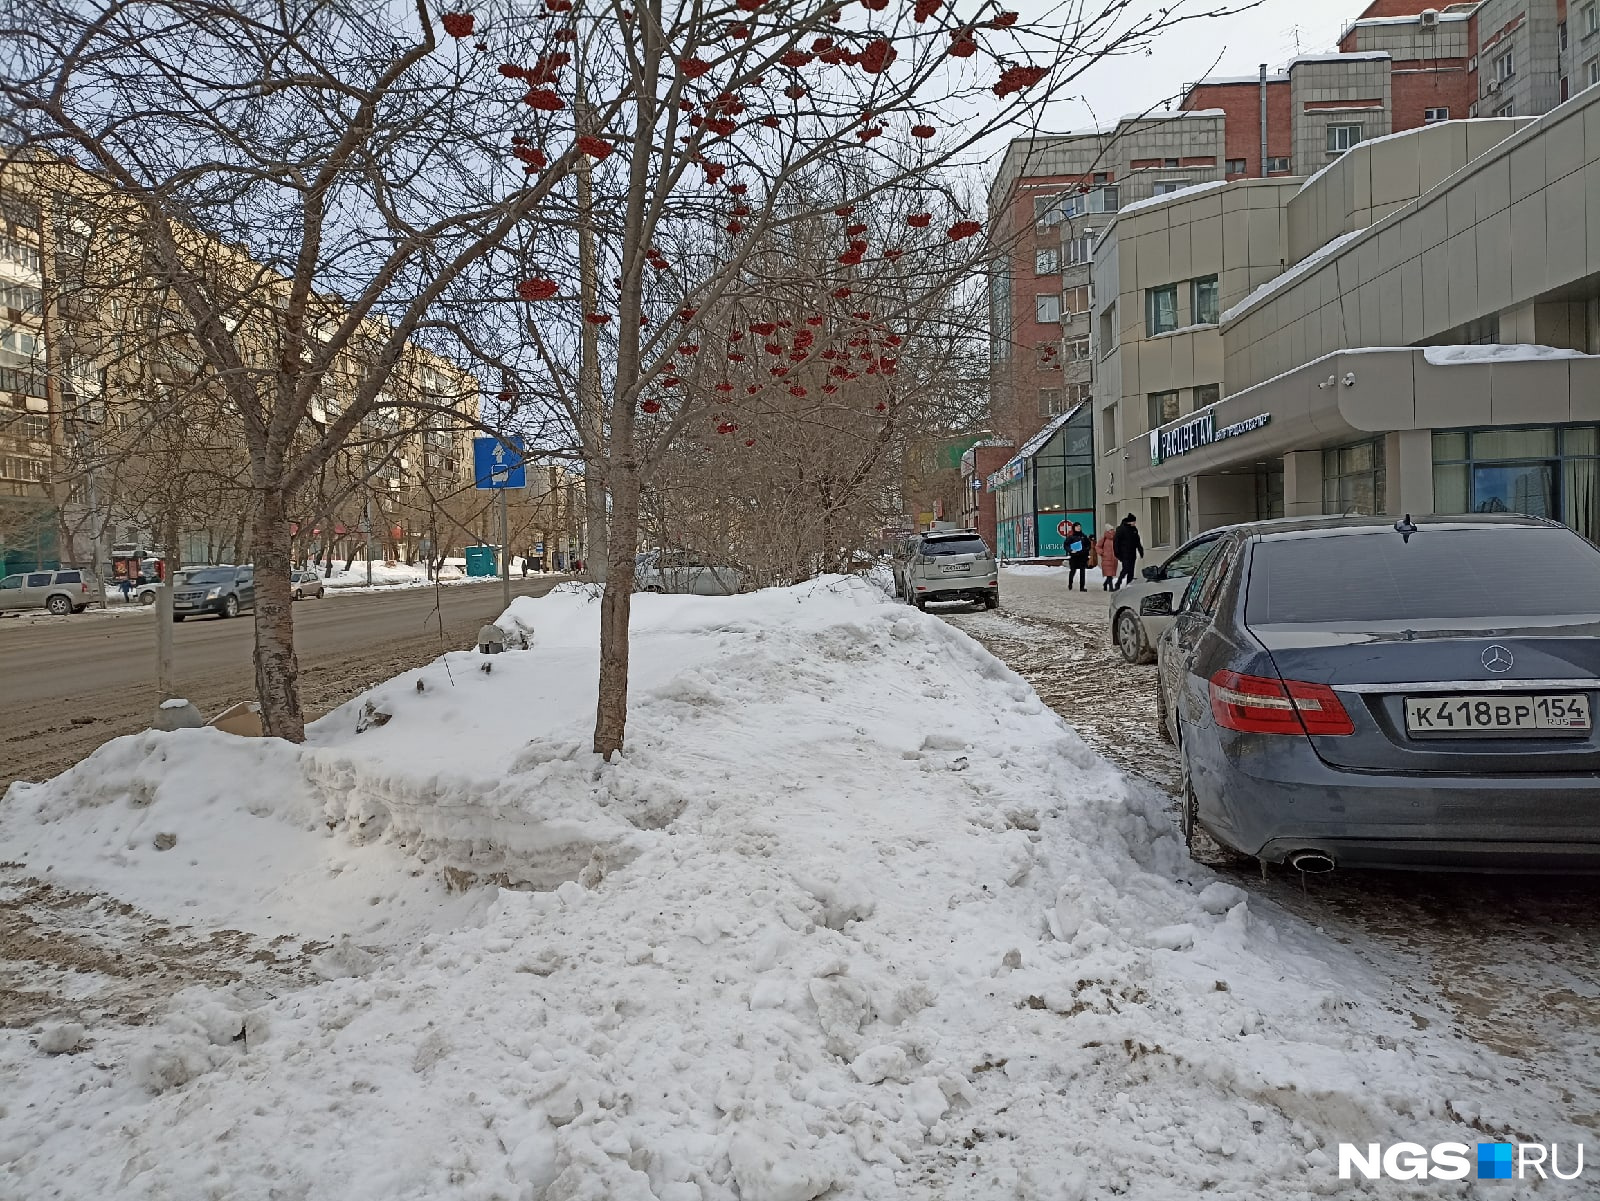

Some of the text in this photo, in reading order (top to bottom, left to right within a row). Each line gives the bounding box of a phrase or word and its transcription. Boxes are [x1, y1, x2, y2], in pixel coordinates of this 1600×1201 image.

[1162, 409, 1214, 459] РАСЦВЕТАЙ
[1416, 698, 1583, 727] К418ВР 154
[1547, 718, 1569, 726] RUS
